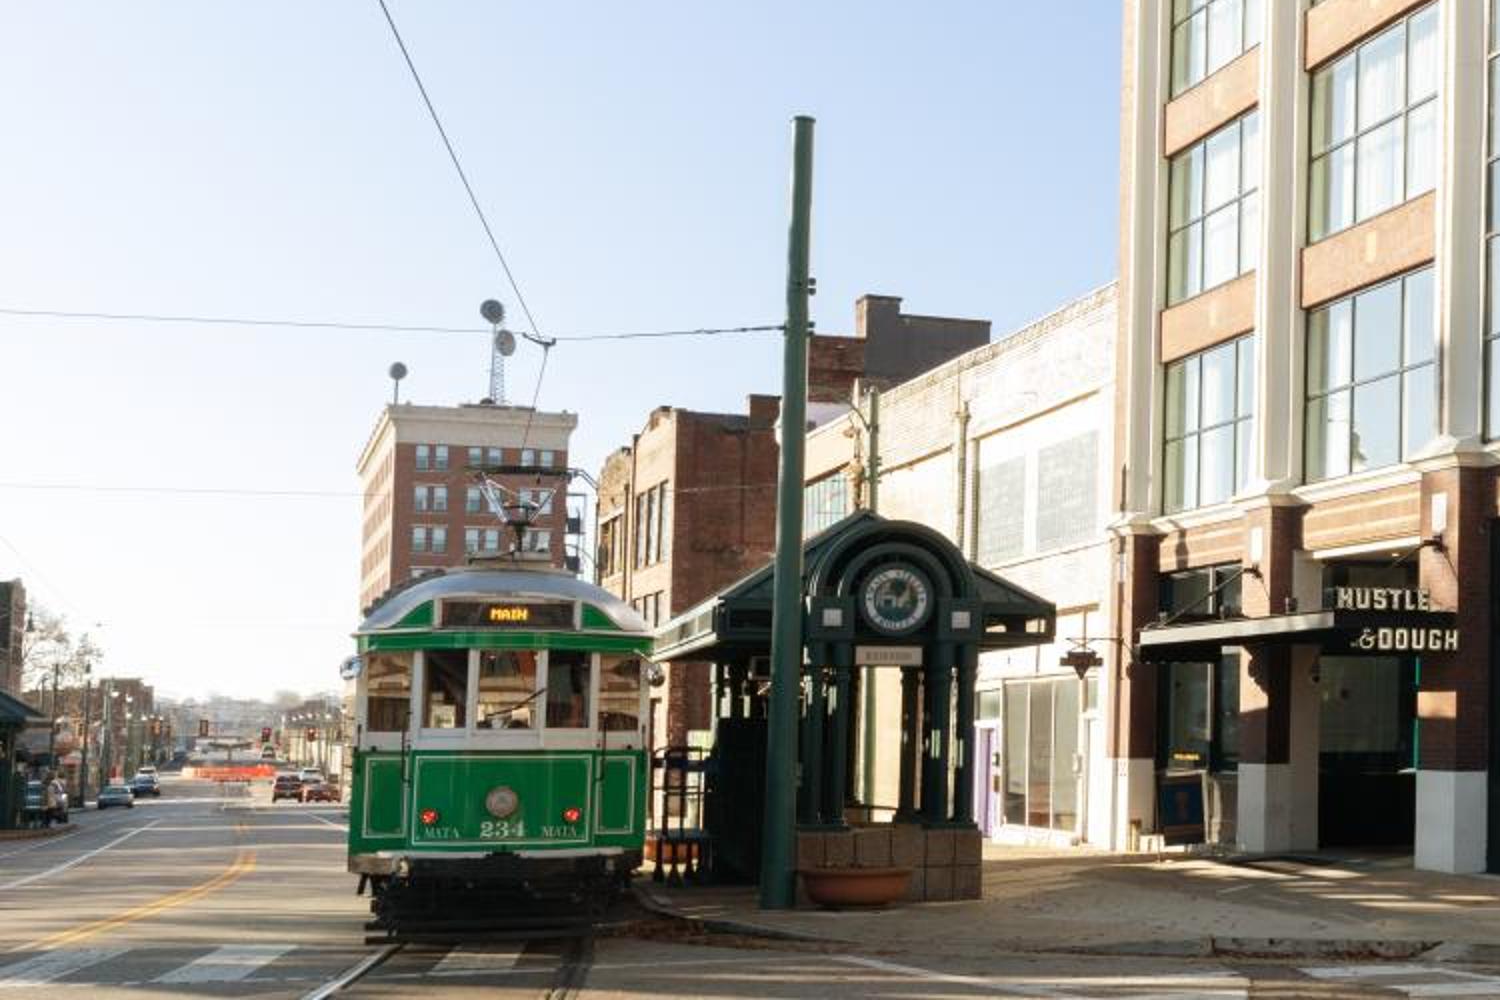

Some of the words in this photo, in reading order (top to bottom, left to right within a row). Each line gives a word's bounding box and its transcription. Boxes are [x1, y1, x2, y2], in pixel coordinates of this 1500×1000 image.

[1337, 587, 1430, 611] HUSTLE
[490, 608, 528, 621] MAIN
[423, 824, 460, 839] MATA
[479, 820, 527, 838] 234
[541, 824, 578, 838] MATA
